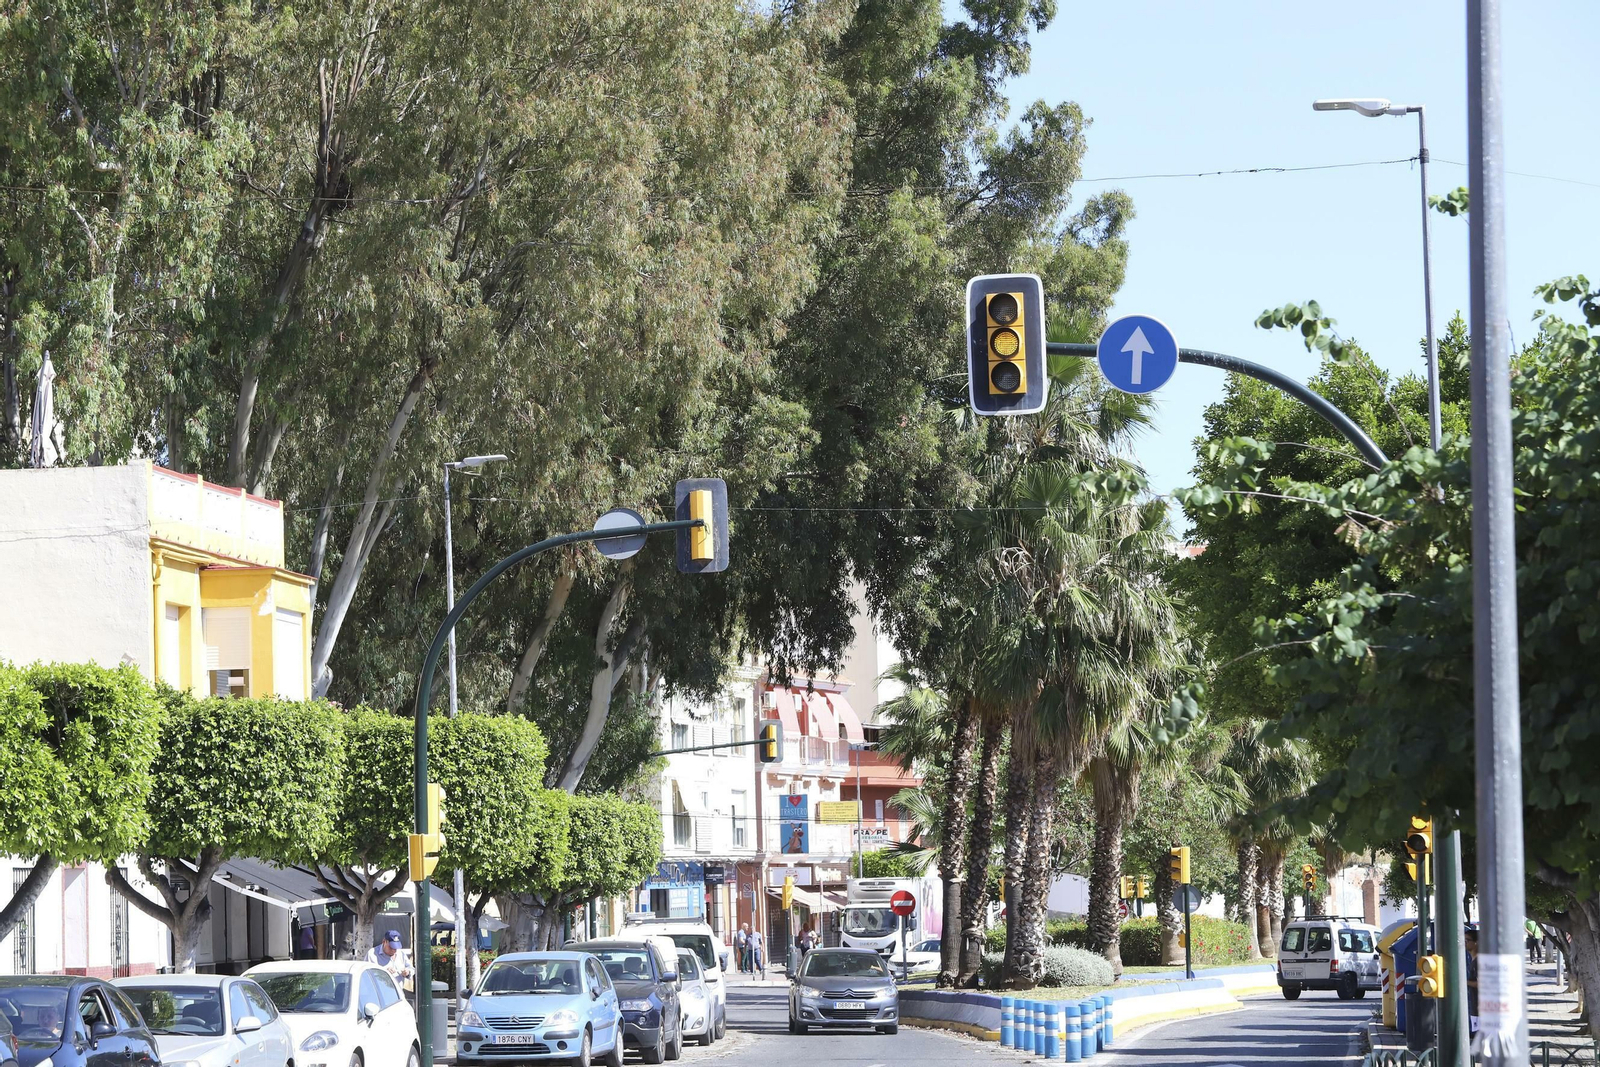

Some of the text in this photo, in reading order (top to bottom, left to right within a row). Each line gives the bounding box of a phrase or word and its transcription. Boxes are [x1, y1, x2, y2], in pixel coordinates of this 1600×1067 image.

[781, 808, 808, 816] TRASTERO
[498, 1035, 532, 1043] 1876 CNY
